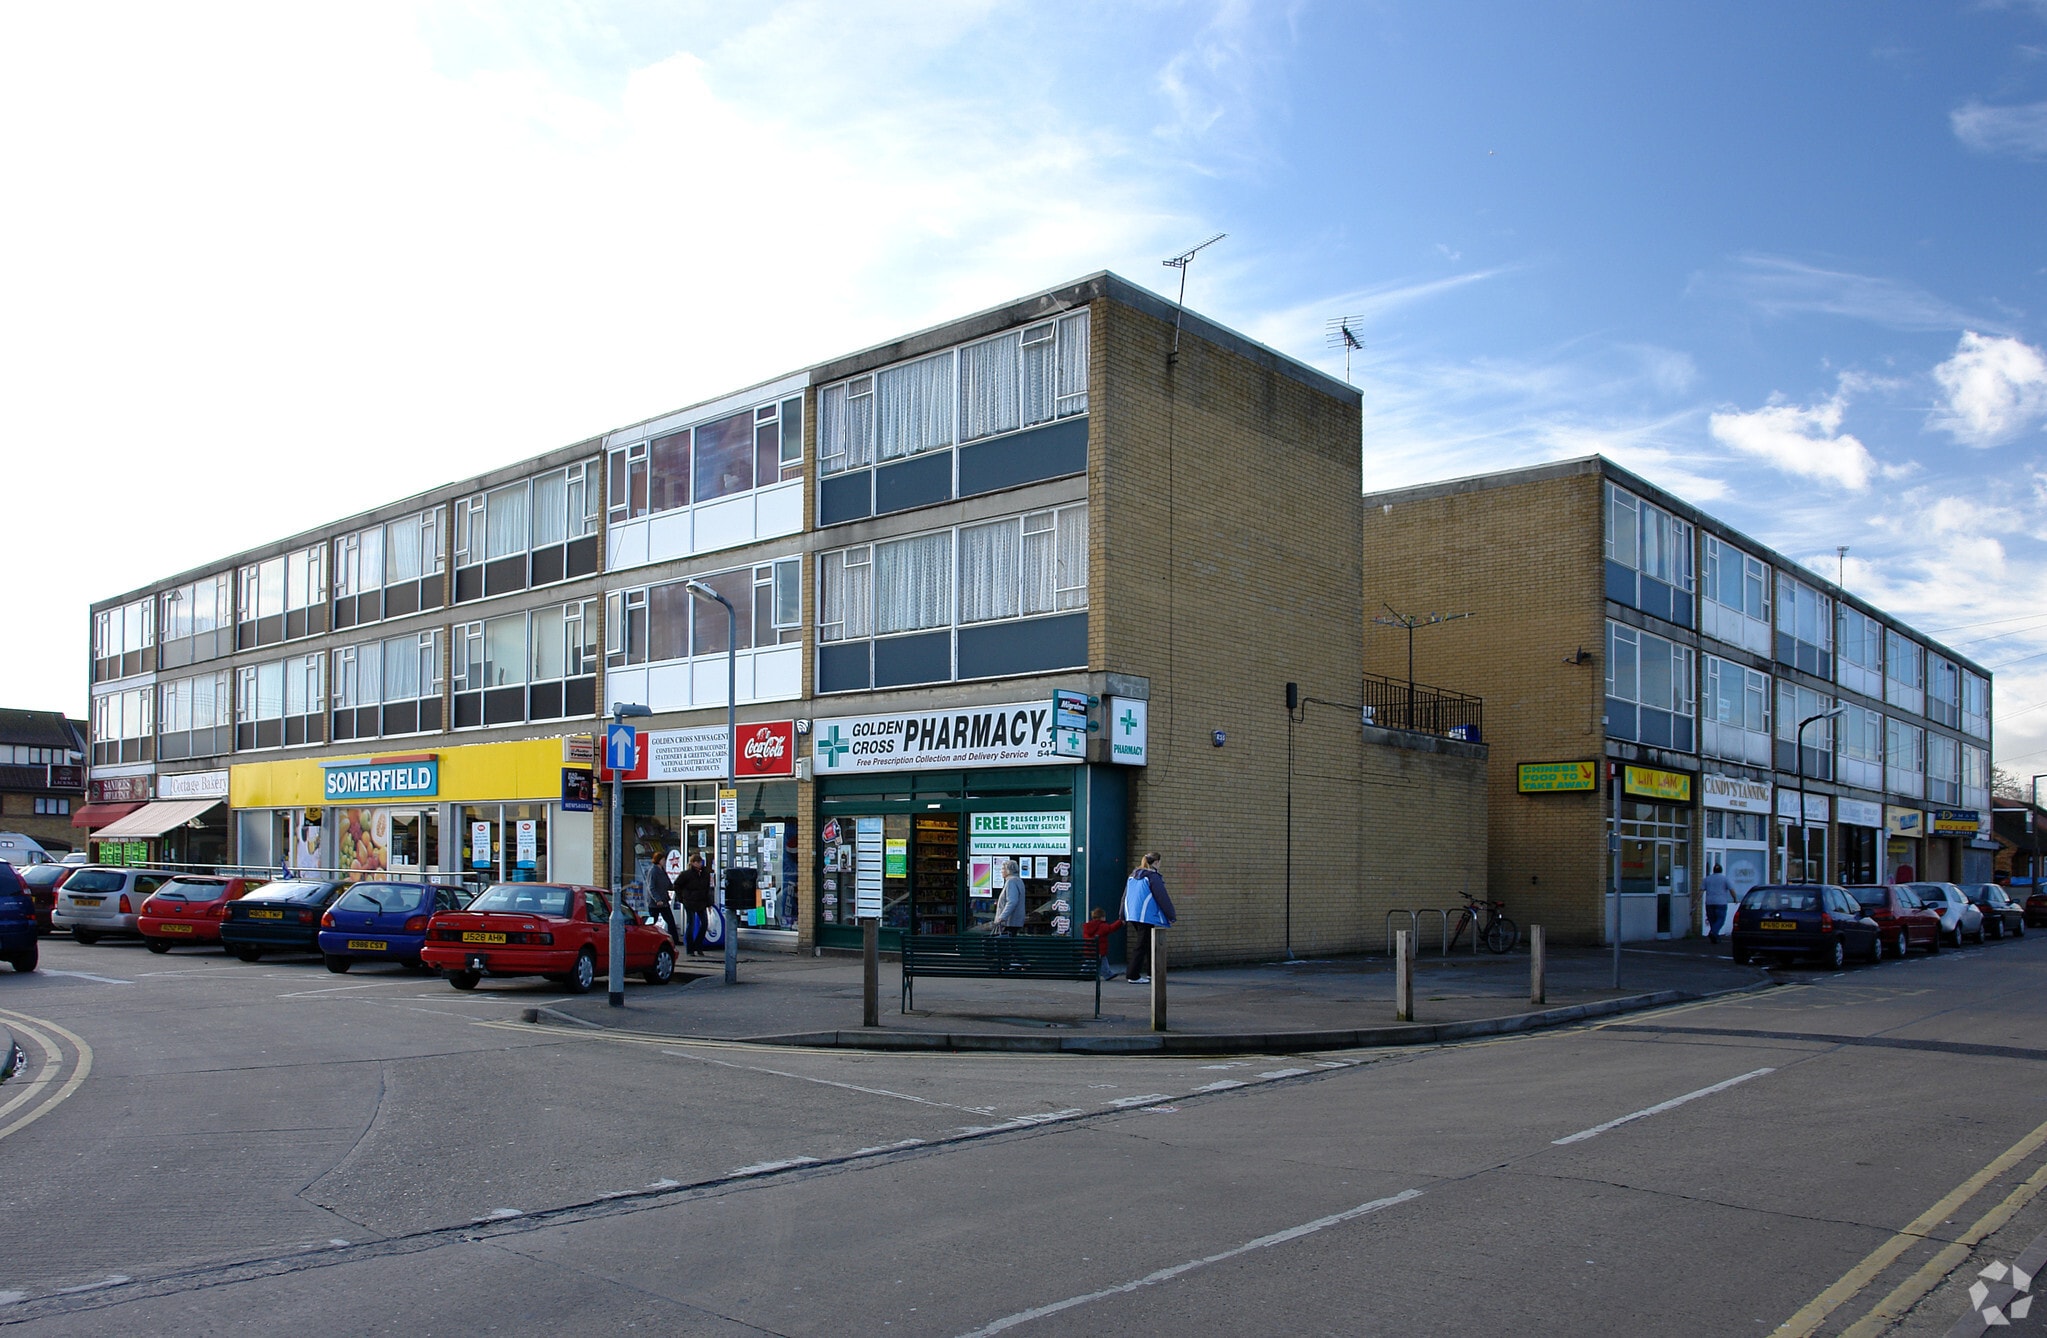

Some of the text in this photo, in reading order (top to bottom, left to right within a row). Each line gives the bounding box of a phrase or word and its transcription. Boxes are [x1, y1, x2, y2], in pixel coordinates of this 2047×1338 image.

[852, 709, 1047, 752] GOLDEN PHARMACY
[652, 736, 675, 745] GOLDEN
[675, 735, 694, 743] CROSS
[852, 740, 894, 755] CROSS
[655, 752, 682, 760] STATIONERY
[1113, 743, 1143, 756] PHARMACY
[856, 750, 1028, 767] Free Prescription Collection and Delivery Service
[1523, 765, 1578, 773] CHINESE
[173, 776, 227, 793] Cottage Bakery
[327, 767, 431, 794] SOMERFIELD
[1705, 778, 1769, 801] CANDY'S TANNING
[975, 817, 1008, 830] FREE
